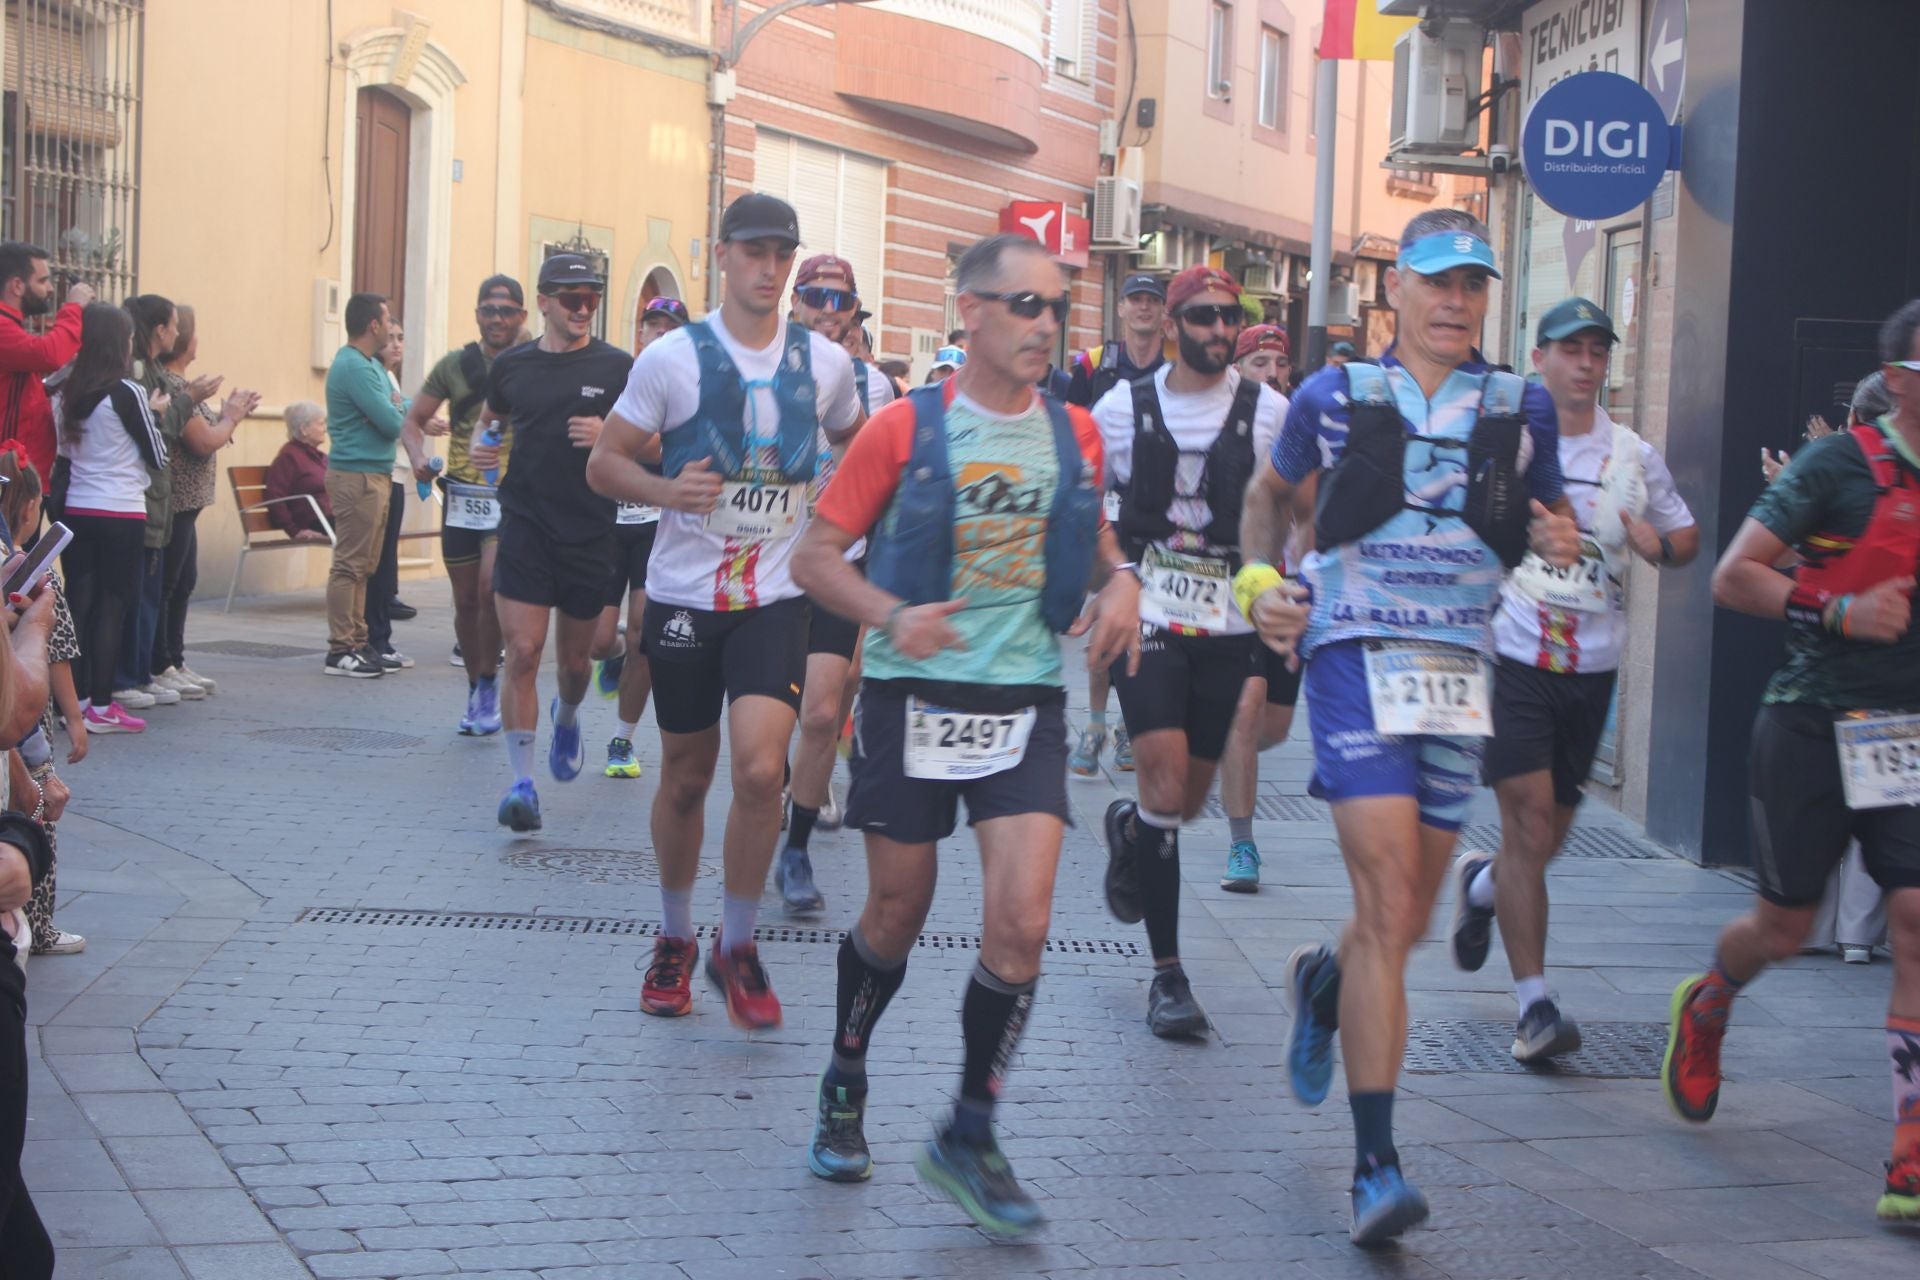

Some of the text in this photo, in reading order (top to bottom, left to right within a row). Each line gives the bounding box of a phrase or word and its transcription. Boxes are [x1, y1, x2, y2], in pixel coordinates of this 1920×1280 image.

[1545, 119, 1648, 158] DIGI
[1544, 161, 1646, 174] Distribuidor oficial
[465, 499, 491, 515] 558
[731, 486, 790, 513] 4071
[1161, 573, 1217, 604] 4072
[1401, 676, 1470, 706] 2112
[939, 718, 1016, 749] 2497
